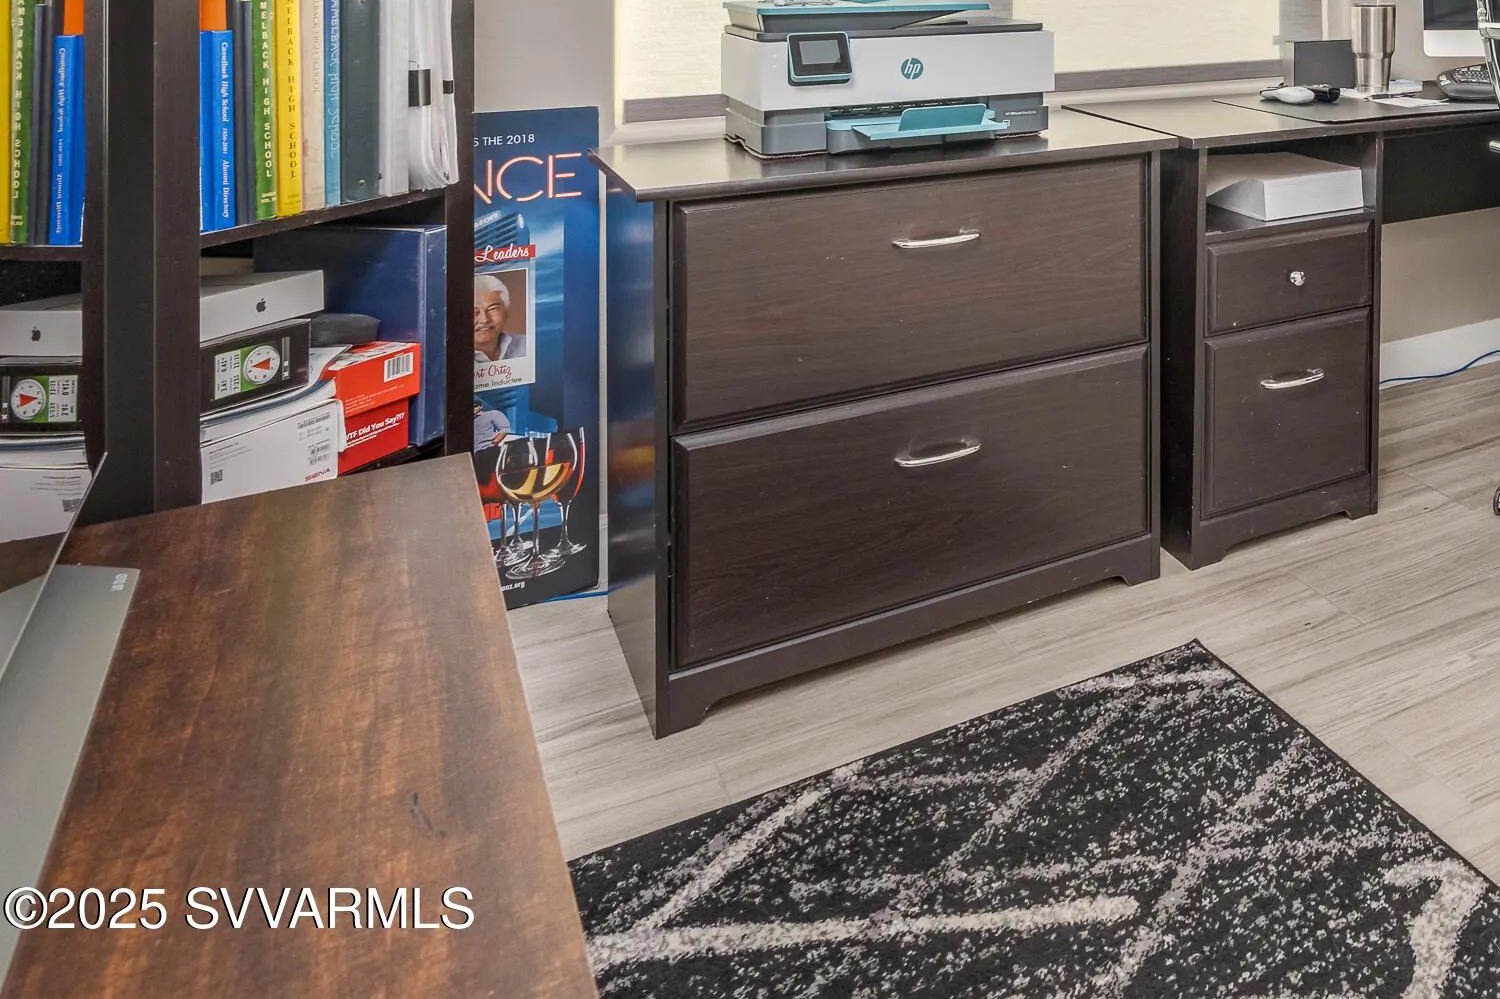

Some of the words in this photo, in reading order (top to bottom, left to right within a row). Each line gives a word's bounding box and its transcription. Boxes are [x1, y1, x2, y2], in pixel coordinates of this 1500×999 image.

[220, 42, 229, 79] Camelback
[904, 59, 922, 78] hp
[220, 80, 229, 98] High
[263, 77, 271, 116] HIGH
[482, 136, 503, 146] THE
[506, 134, 535, 145] 2018
[264, 122, 272, 178] SCHOOL
[221, 187, 230, 218] Directory
[475, 243, 529, 263] Leaders
[488, 365, 512, 379] Ortiz
[492, 377, 523, 387] Inductee
[358, 424, 370, 436] Did
[371, 421, 385, 432] You
[304, 467, 331, 482] SENA
